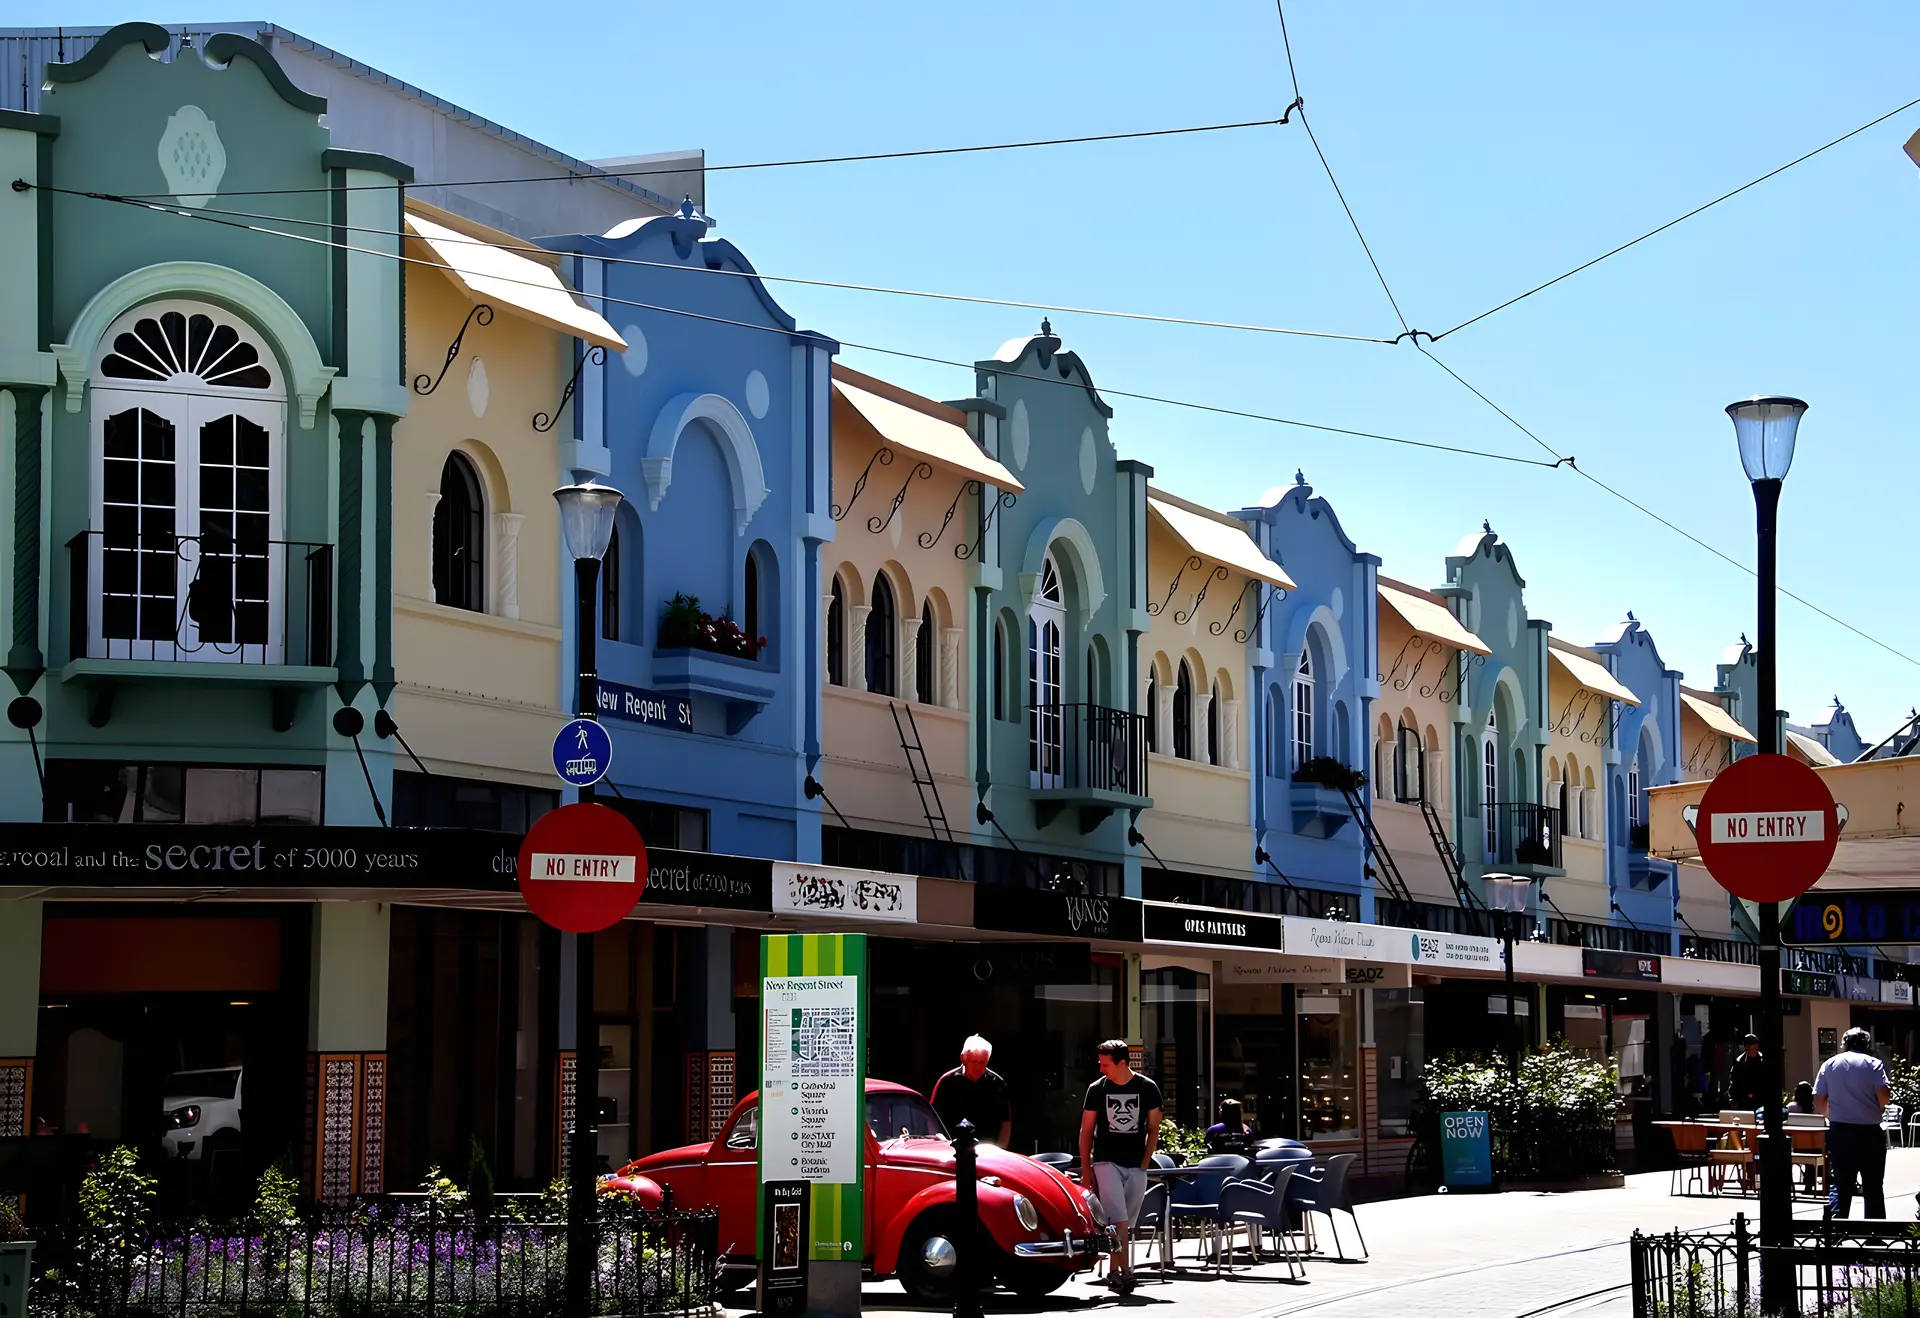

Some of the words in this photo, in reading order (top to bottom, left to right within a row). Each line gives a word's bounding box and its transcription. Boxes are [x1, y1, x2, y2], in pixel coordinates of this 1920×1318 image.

[625, 691, 667, 723] Regent
[679, 702, 691, 726] St
[1727, 818, 1748, 838] NO
[1757, 816, 1807, 837] ENTRY
[74, 852, 106, 868] and
[112, 851, 140, 867] the
[145, 839, 267, 871] secret
[273, 848, 298, 868] of
[303, 848, 357, 868] 5000
[365, 853, 418, 873] years
[546, 858, 565, 876] NO
[573, 858, 620, 877] ENTRY
[1207, 920, 1247, 937] PARTNERS
[766, 980, 785, 990] New
[787, 980, 816, 991] Regent
[818, 979, 843, 990] Street
[801, 1082, 836, 1090] Cathedral
[801, 1091, 826, 1099] Square
[801, 1116, 826, 1124] Square
[1444, 1117, 1484, 1128] OPEN
[1446, 1127, 1483, 1138] NOW
